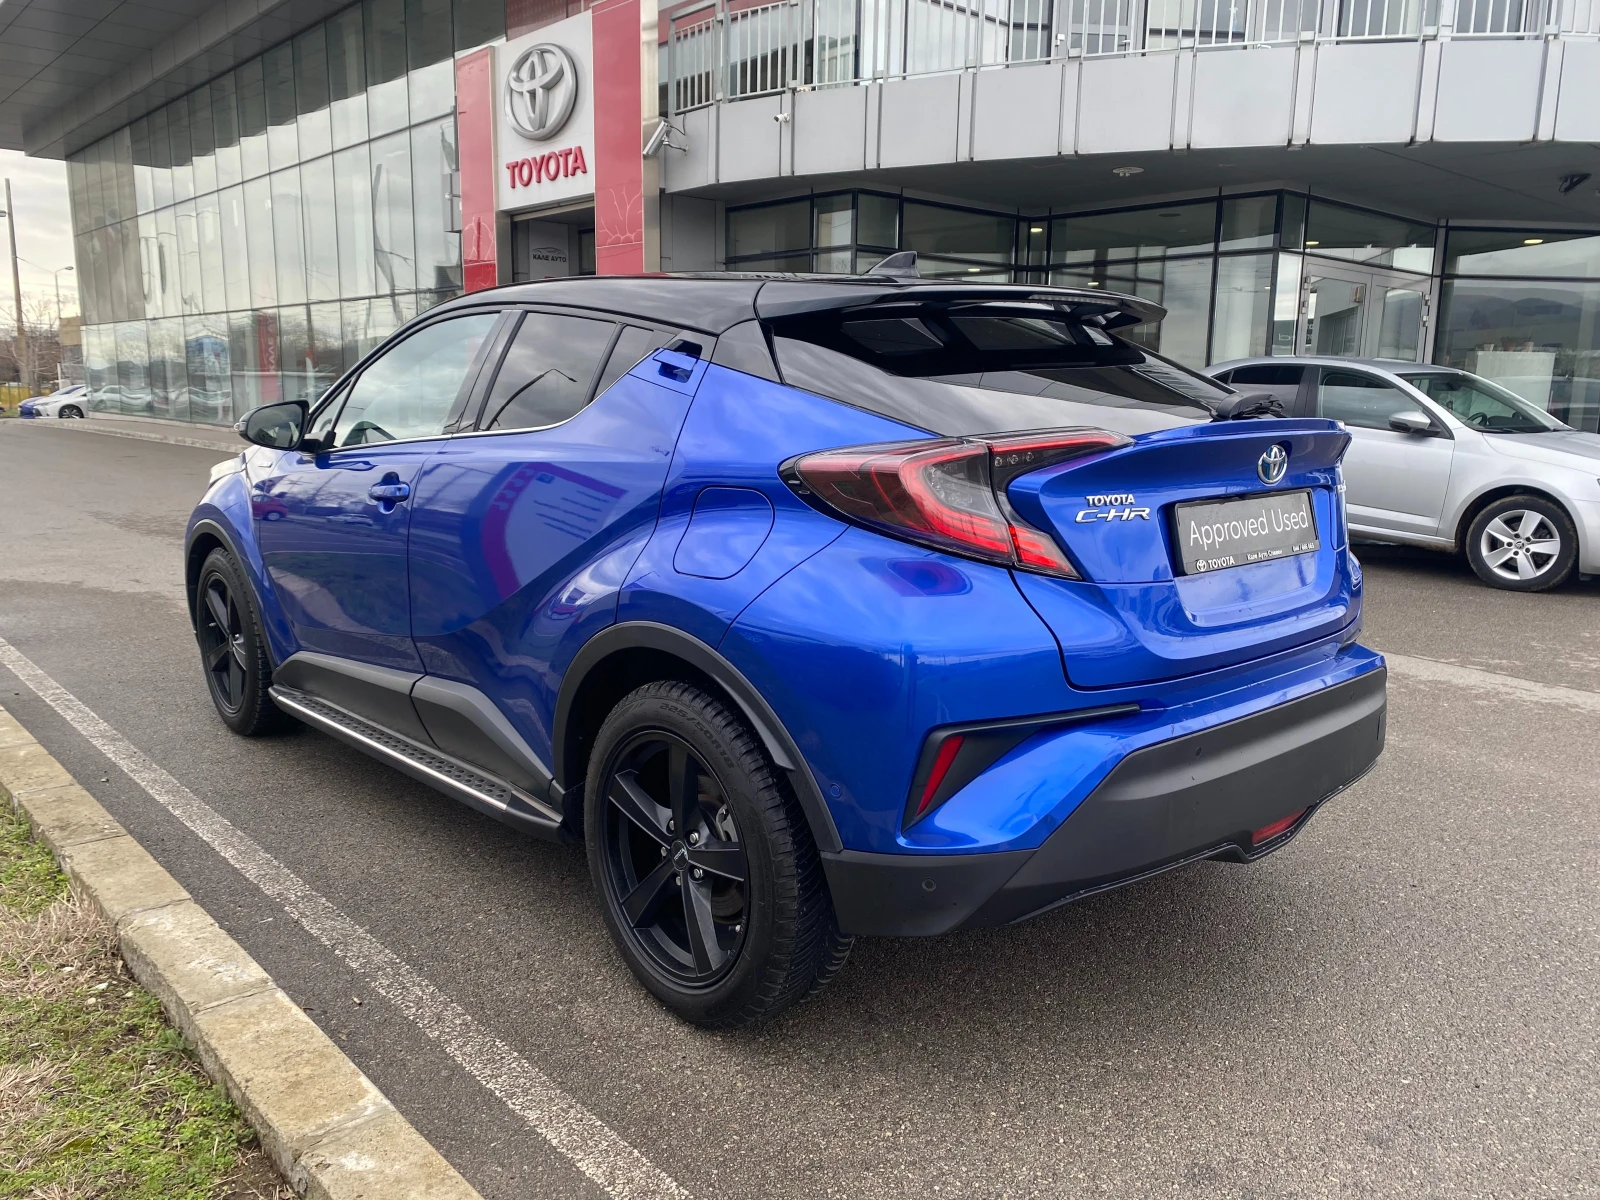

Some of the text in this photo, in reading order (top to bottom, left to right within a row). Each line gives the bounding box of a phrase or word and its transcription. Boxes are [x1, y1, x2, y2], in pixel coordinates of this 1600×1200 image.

[505, 145, 588, 189] TOYOTA
[551, 255, 567, 263] АУТО
[1085, 494, 1135, 507] TOYOTA
[1075, 507, 1151, 523] C-HR
[1190, 504, 1309, 550] Approved Used
[1207, 555, 1236, 569] TOYOTA
